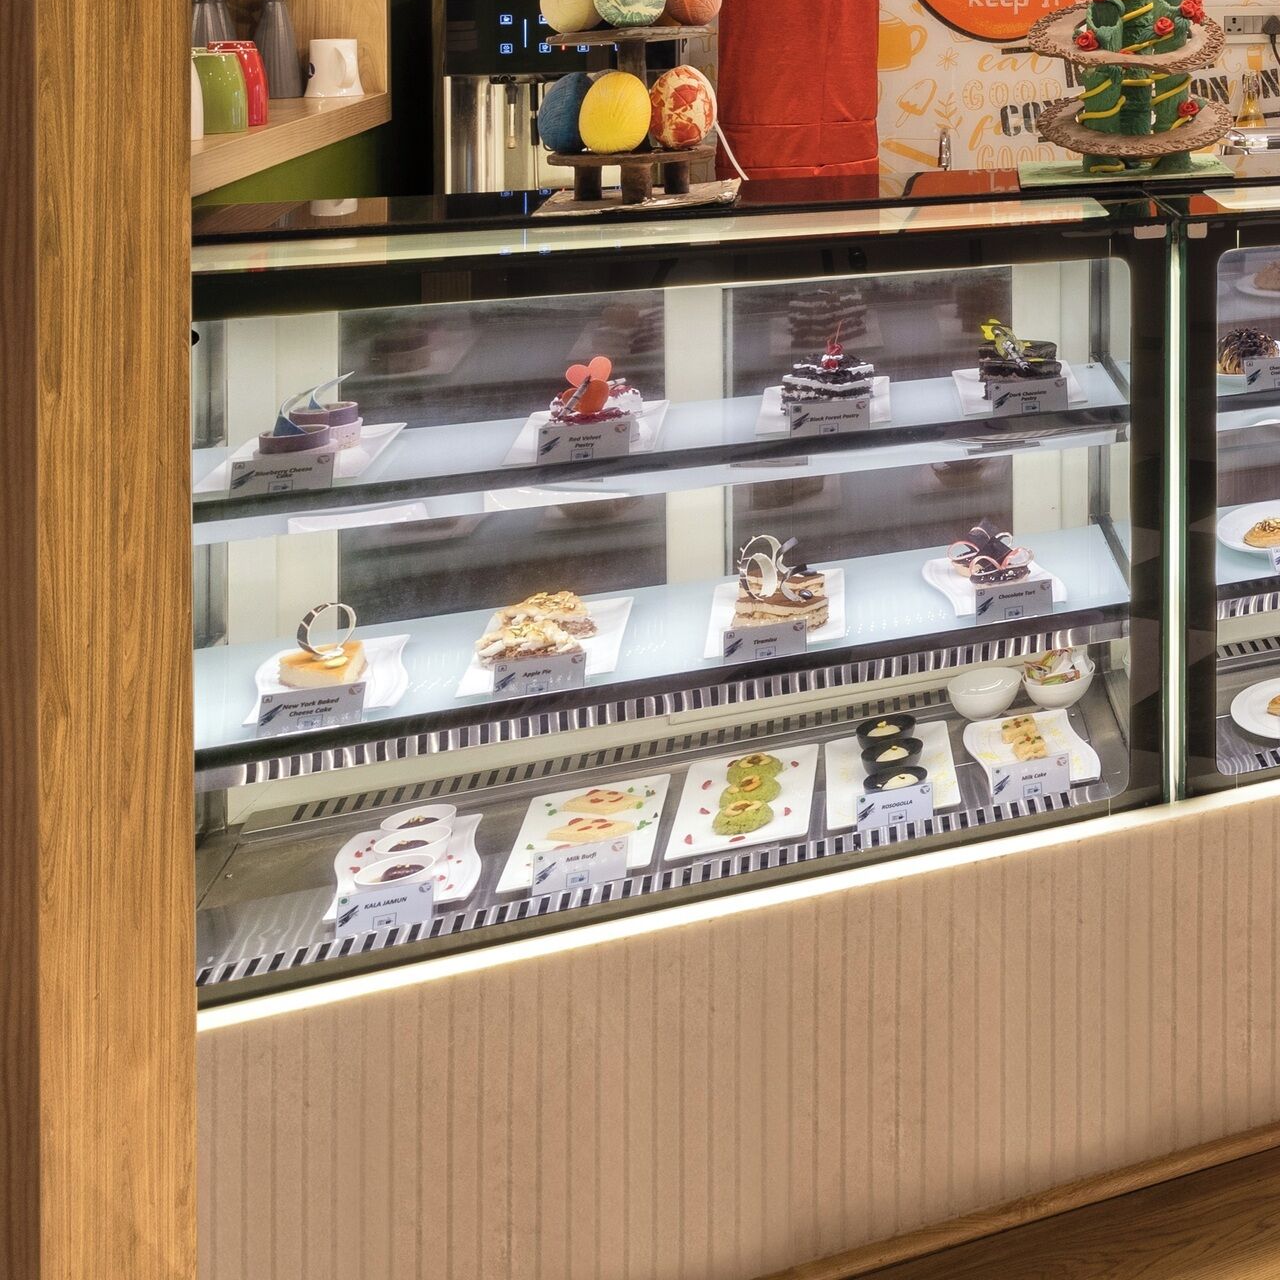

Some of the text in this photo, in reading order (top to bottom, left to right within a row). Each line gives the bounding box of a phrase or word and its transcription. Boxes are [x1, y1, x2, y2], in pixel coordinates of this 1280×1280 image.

[962, 77, 1063, 111] GOOD
[281, 697, 340, 711] New York Baked
[288, 710, 313, 718] Cheese
[363, 896, 408, 910] KALA JAMUN
